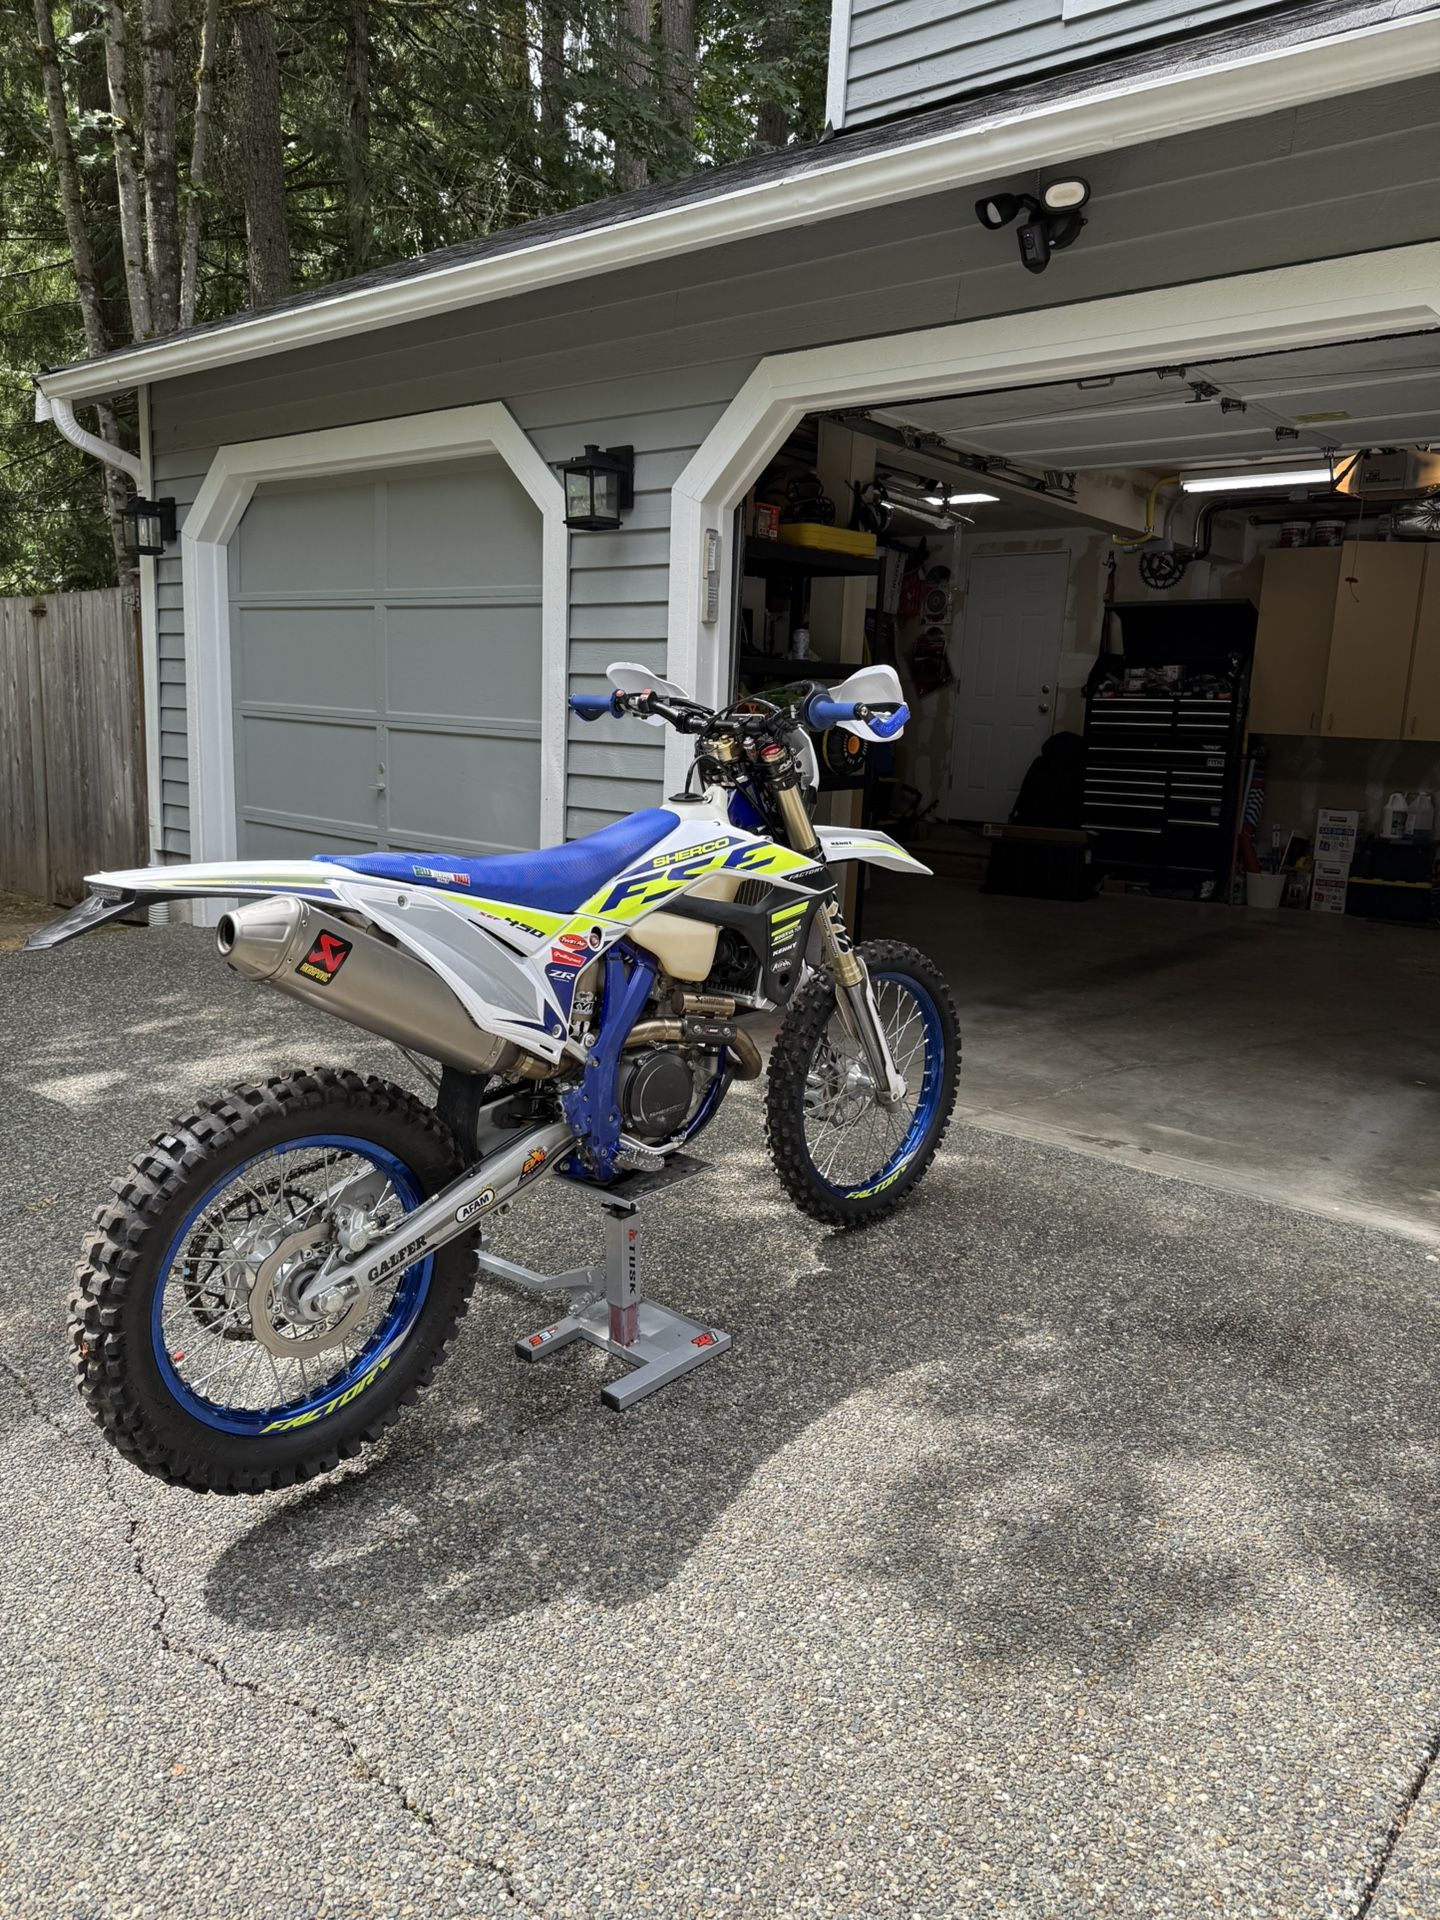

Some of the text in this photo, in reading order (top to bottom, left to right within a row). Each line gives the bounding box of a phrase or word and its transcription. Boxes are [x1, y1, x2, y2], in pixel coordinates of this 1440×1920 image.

[652, 837, 730, 868] SHERCO
[597, 840, 777, 914] FSE
[787, 866, 825, 881] FACTORY
[504, 916, 547, 938] 450
[561, 936, 576, 945] Twin
[772, 941, 798, 957] KENNY
[548, 969, 575, 981] ZR
[844, 1164, 908, 1200] FACTORY
[462, 1193, 490, 1219] AFAM
[367, 1235, 428, 1282] GALFER
[628, 1243, 637, 1296] TUSK
[258, 1355, 392, 1434] FACTORY
